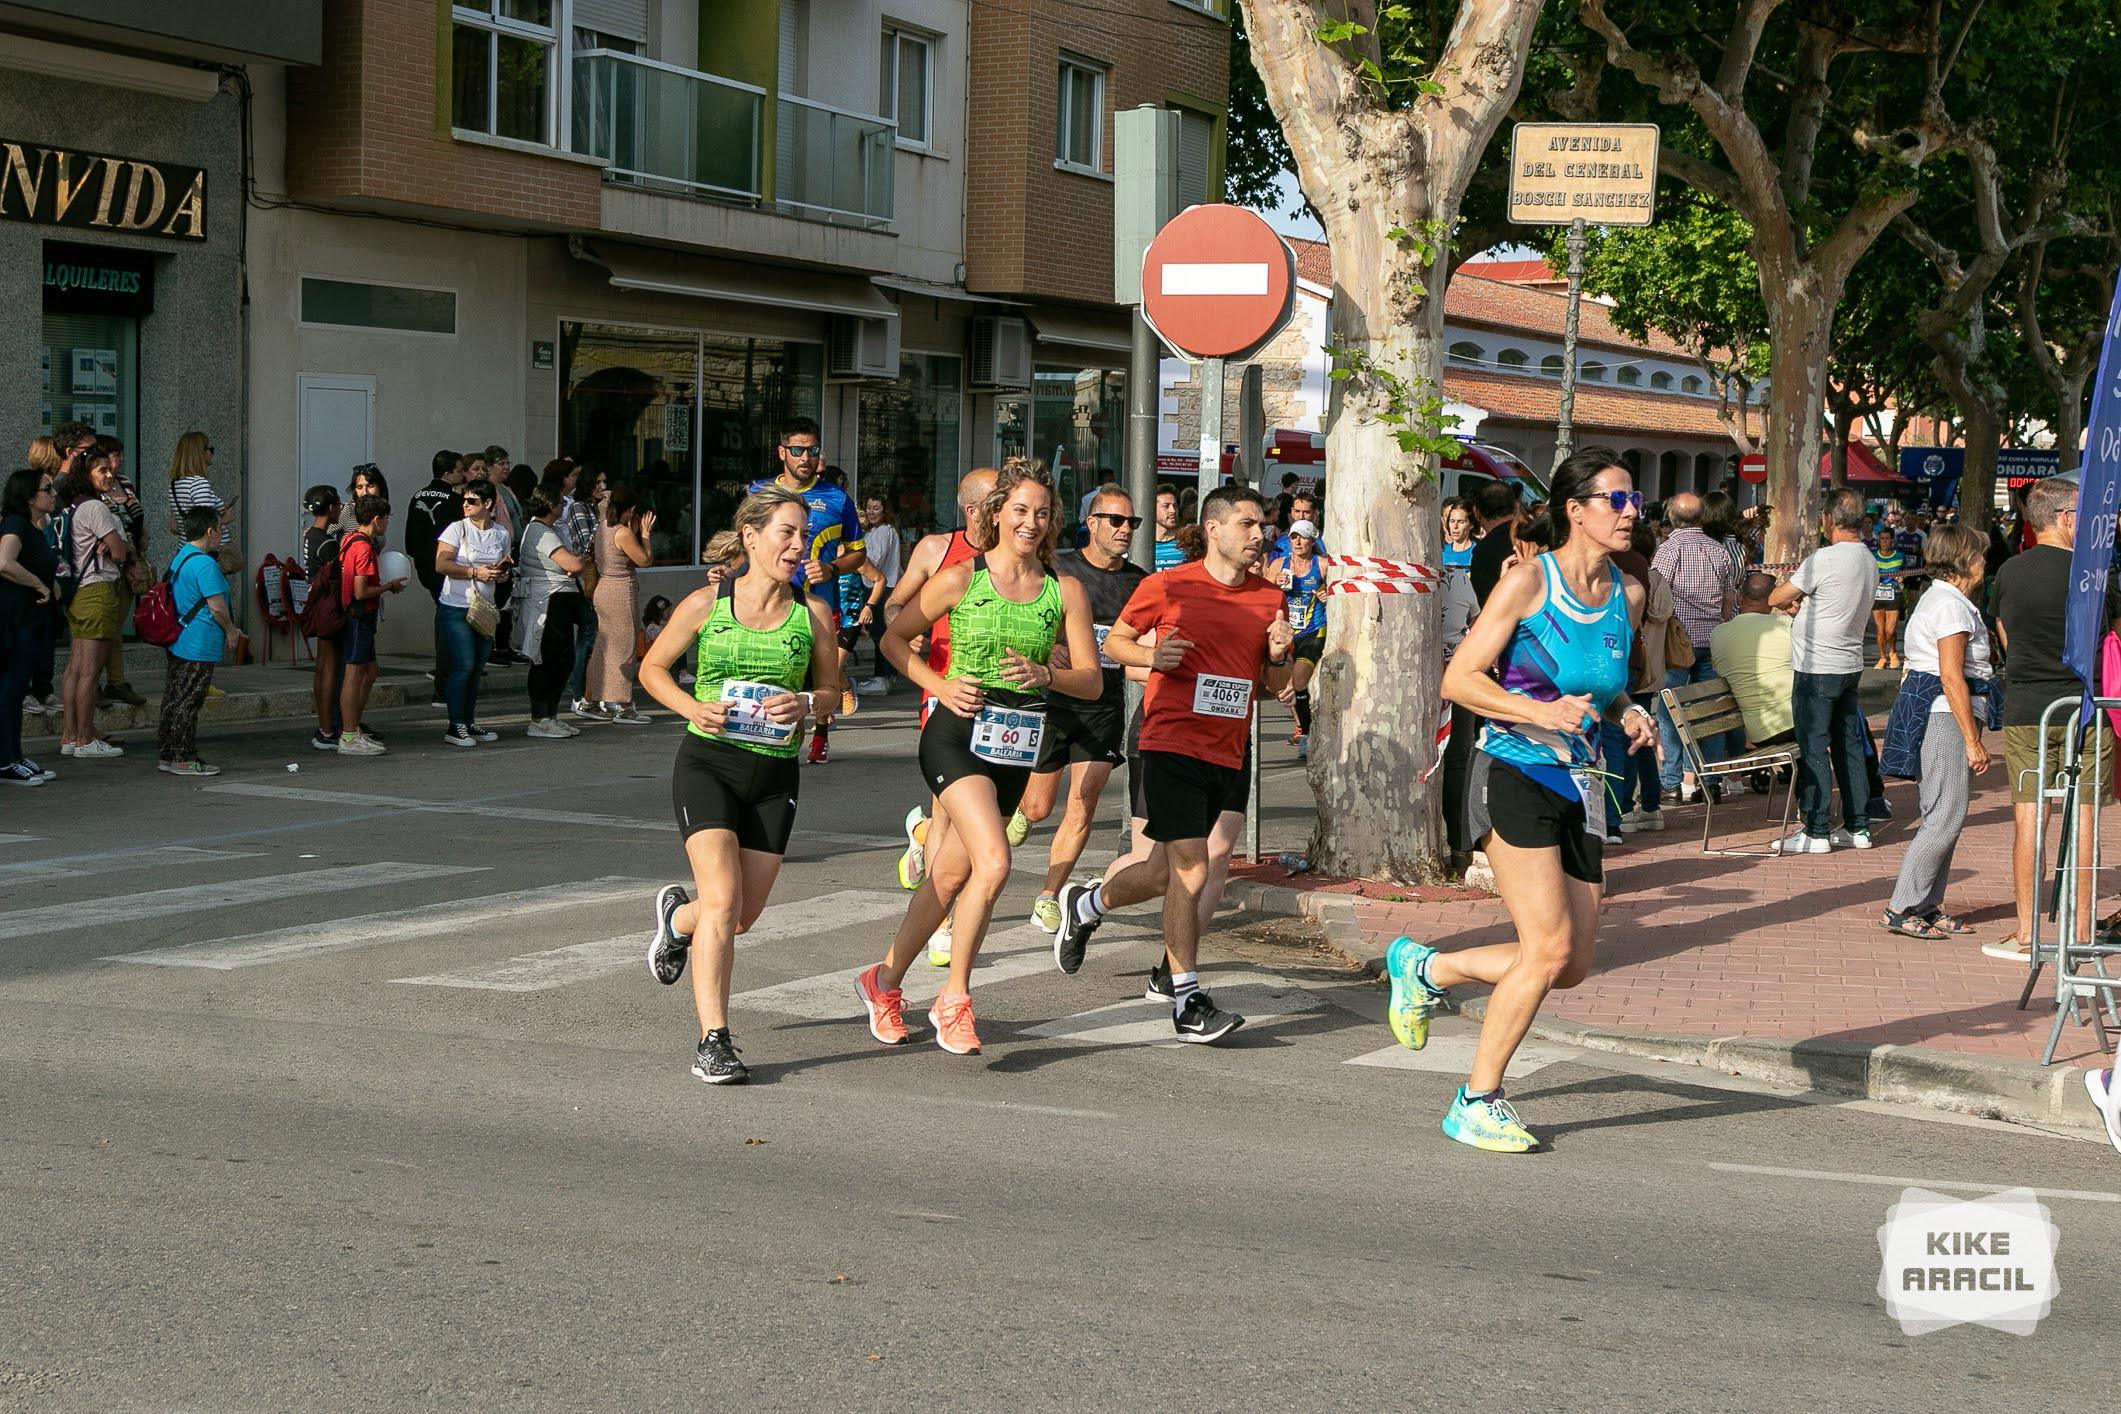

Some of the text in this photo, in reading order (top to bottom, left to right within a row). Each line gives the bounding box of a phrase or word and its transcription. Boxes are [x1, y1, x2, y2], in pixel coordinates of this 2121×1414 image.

[1548, 136, 1622, 152] AVENIDA
[1522, 162, 1556, 178] DEL
[1512, 190, 1650, 208] BOSCH SANCHEZ
[1212, 688, 1240, 703] 4069
[1210, 705, 1239, 714] ONDARA
[739, 723, 776, 736] BALEARIA
[1001, 730, 1020, 745] 60
[990, 747, 1023, 759] BALEARIA
